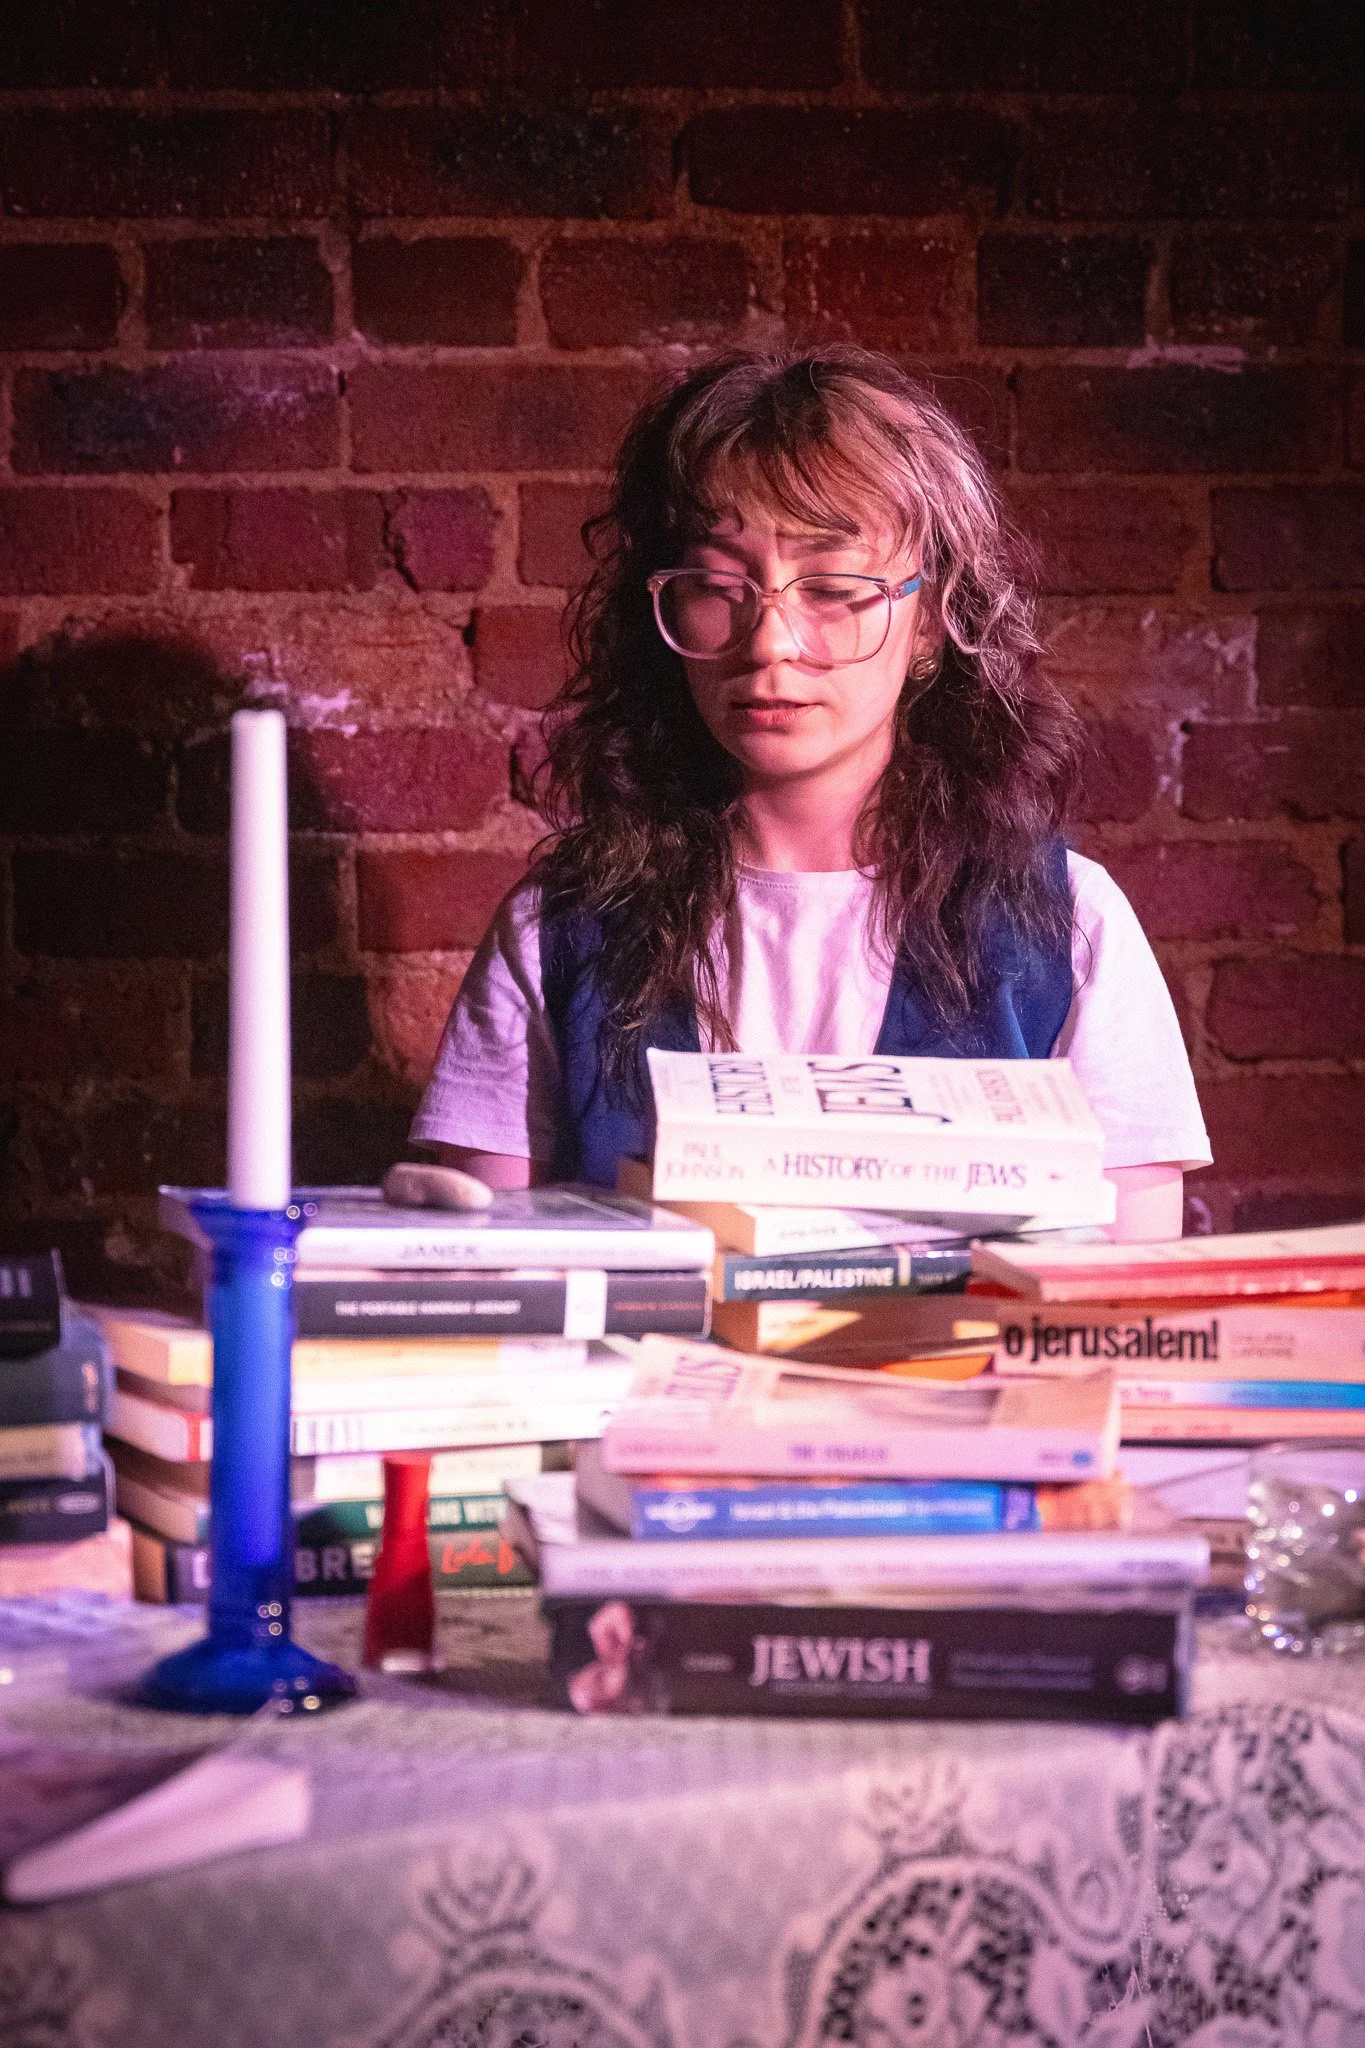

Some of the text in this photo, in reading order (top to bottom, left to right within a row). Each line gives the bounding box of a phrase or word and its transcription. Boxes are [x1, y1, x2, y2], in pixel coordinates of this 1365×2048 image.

[807, 1061, 952, 1125] JEWS
[781, 1153, 889, 1182] HISTORY
[889, 1164, 913, 1182] OF
[922, 1164, 961, 1184] THE
[963, 1162, 1028, 1194] JEWS
[733, 1266, 896, 1291] ISRAEL/PALESTINE
[1028, 1314, 1219, 1363] jerusalem!
[749, 1633, 933, 1687] JEWISH
